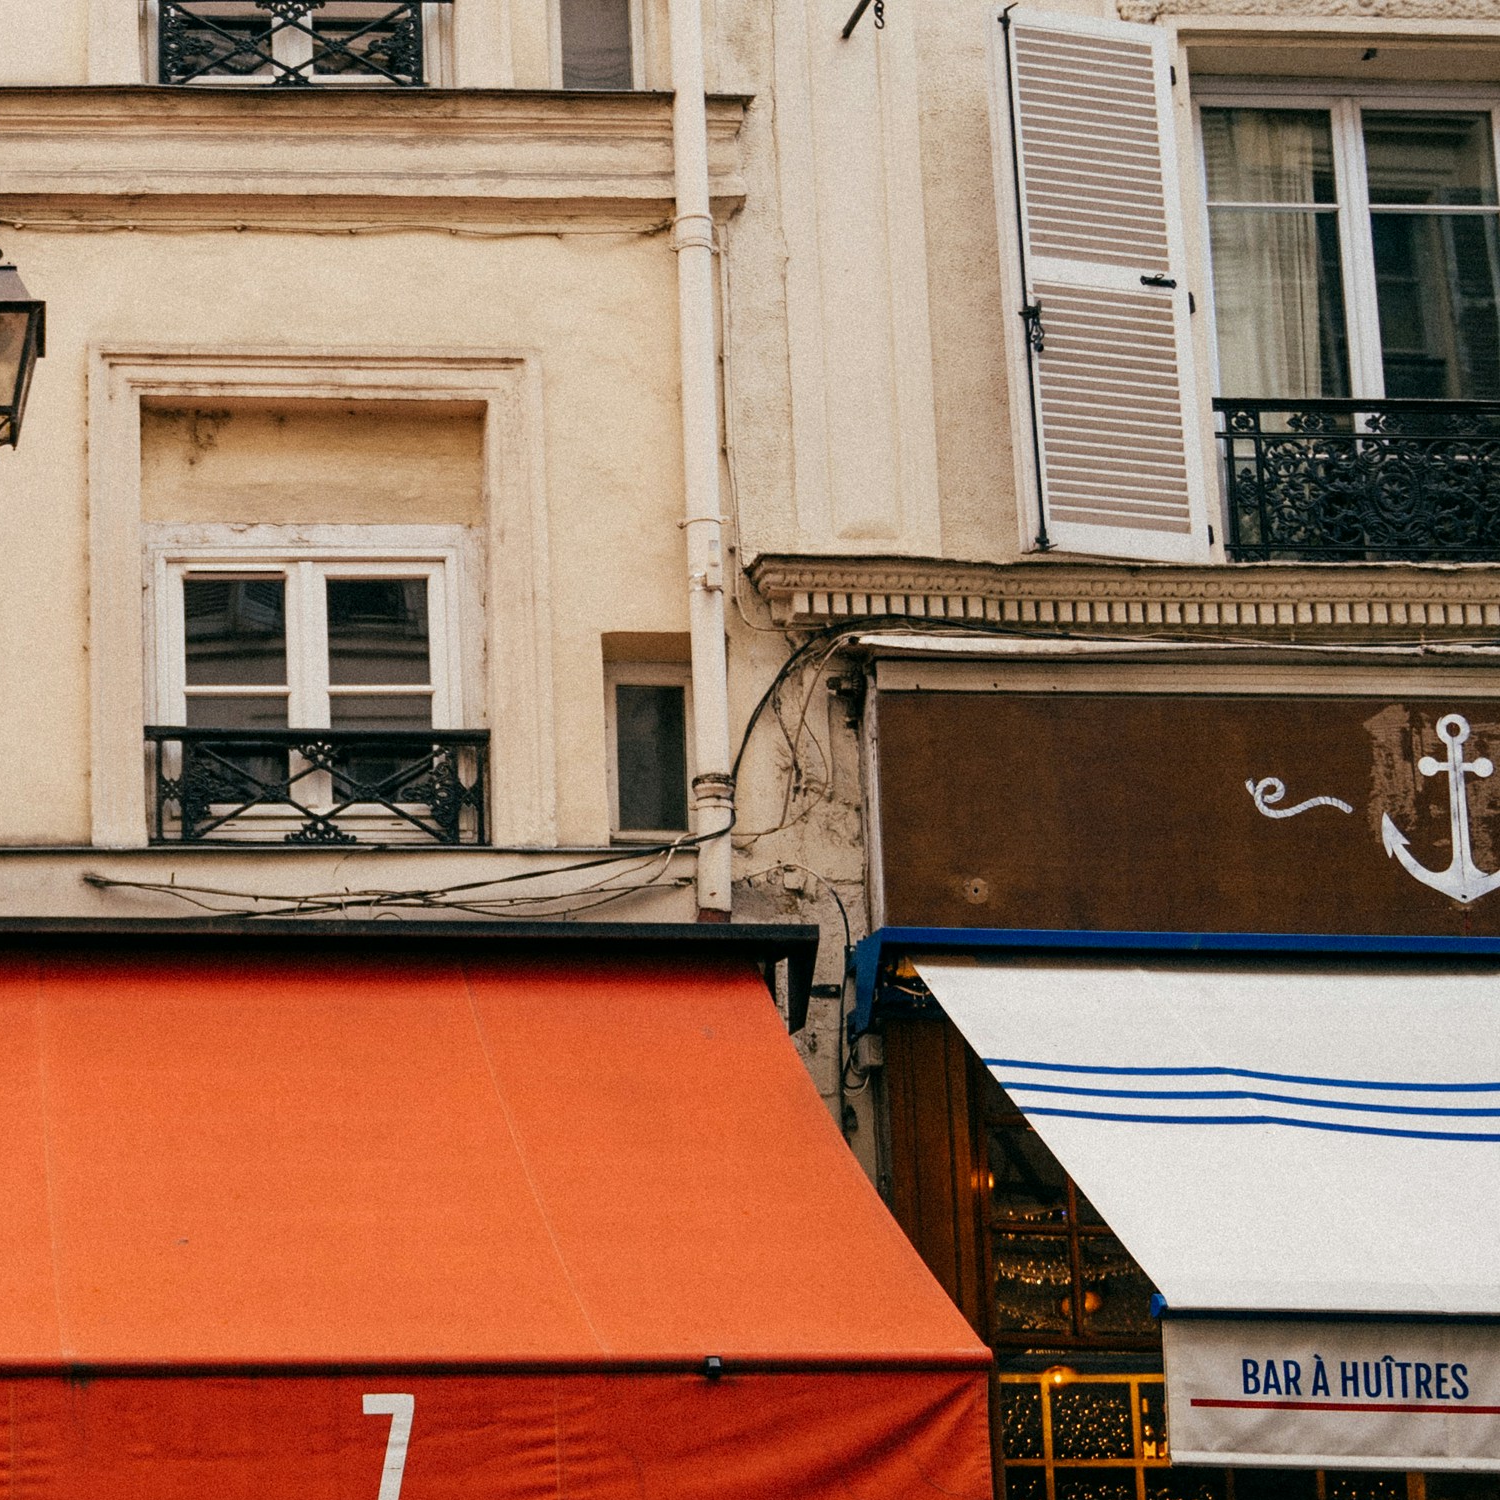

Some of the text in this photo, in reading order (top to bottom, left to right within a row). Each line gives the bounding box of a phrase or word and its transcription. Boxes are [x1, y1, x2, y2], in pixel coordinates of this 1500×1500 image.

[1242, 1354, 1469, 1400] BAR À HUÎTRES
